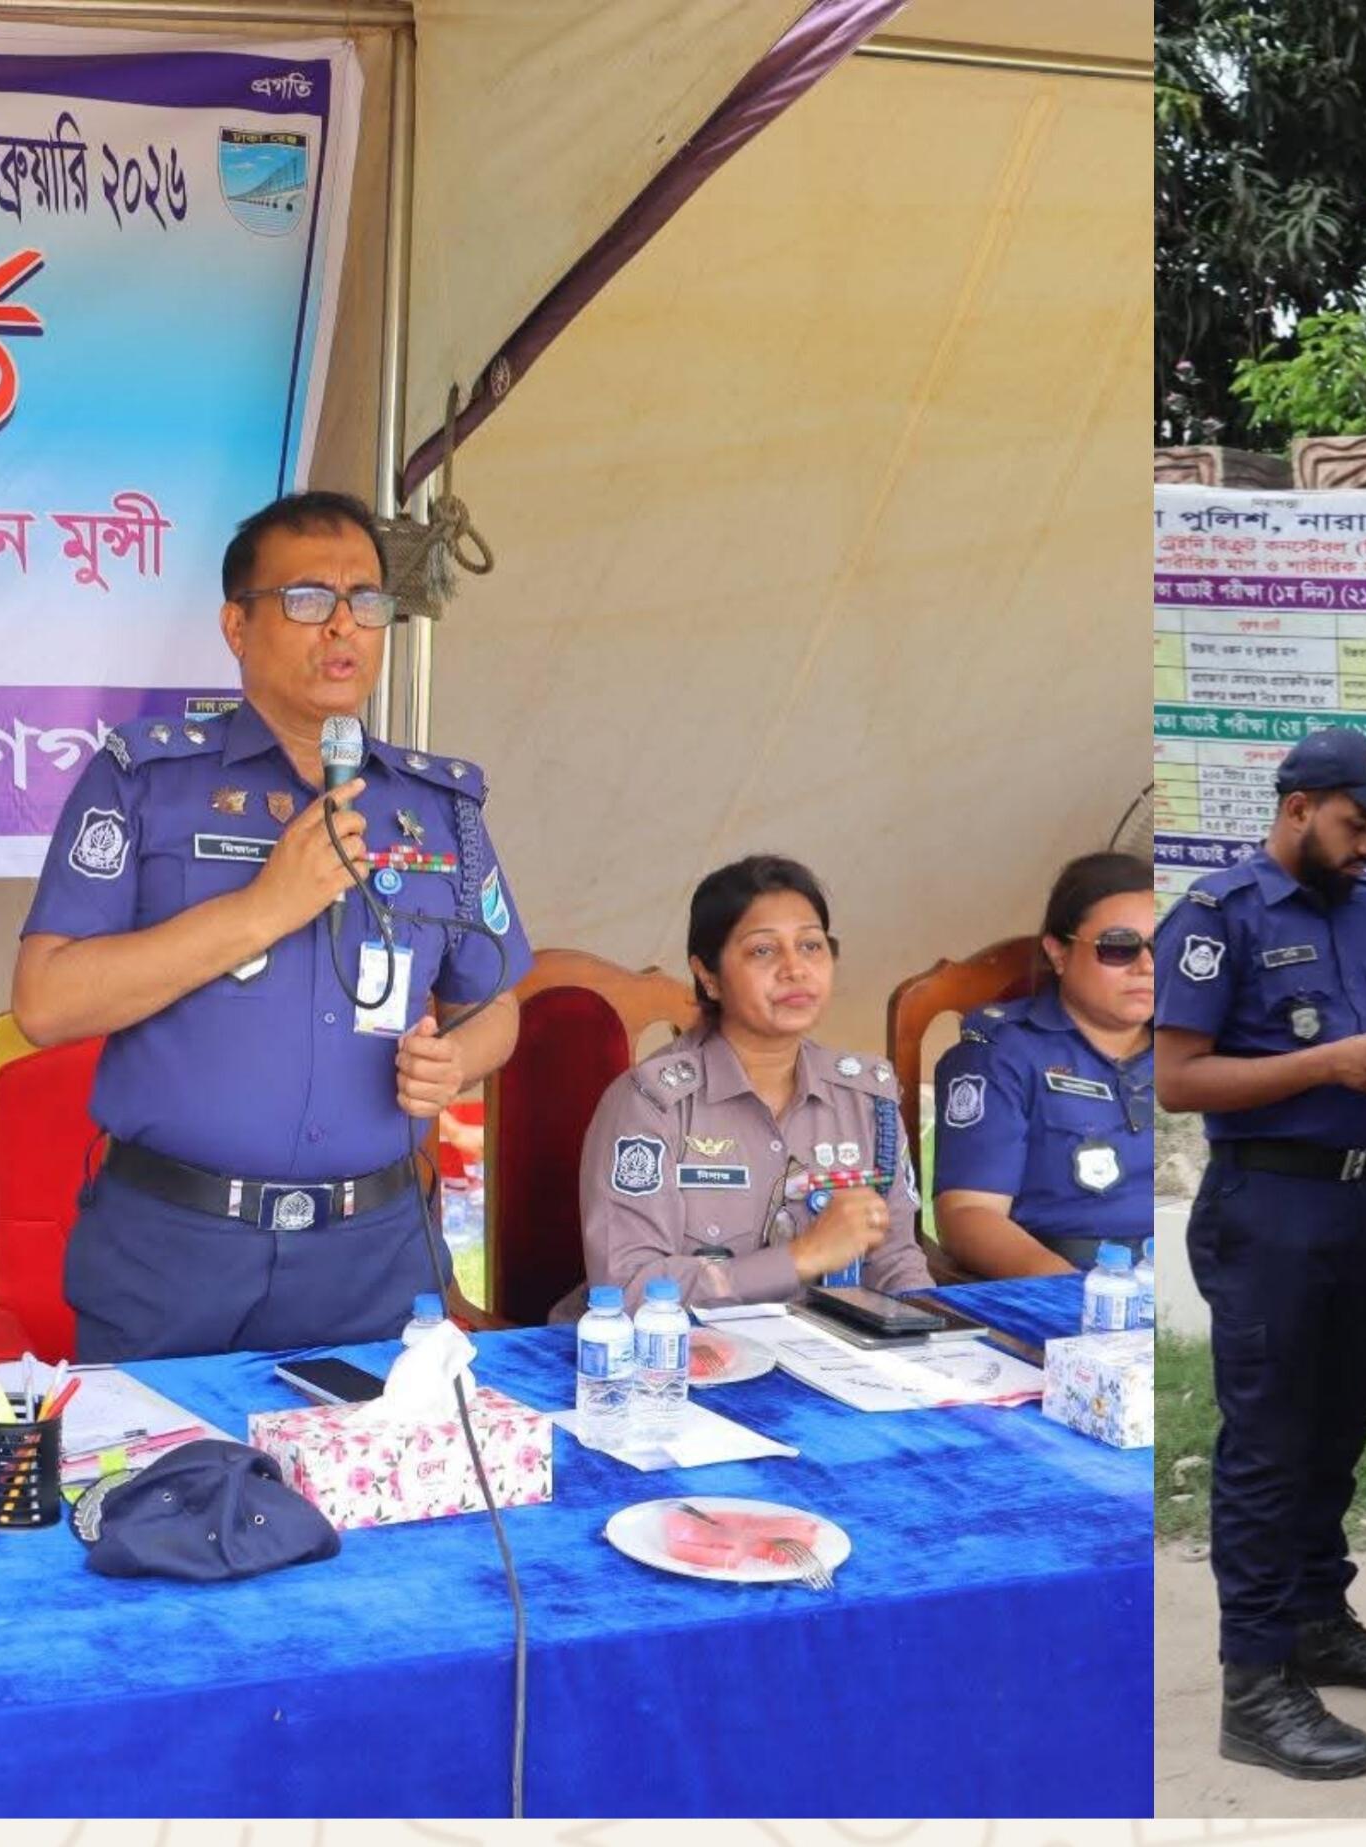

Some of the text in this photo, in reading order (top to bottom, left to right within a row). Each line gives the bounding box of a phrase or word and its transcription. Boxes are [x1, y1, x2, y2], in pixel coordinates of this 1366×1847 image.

[250, 73, 313, 102] প্রগতি
[102, 143, 188, 231] ২০২৬
[51, 489, 171, 591] মুন্সী
